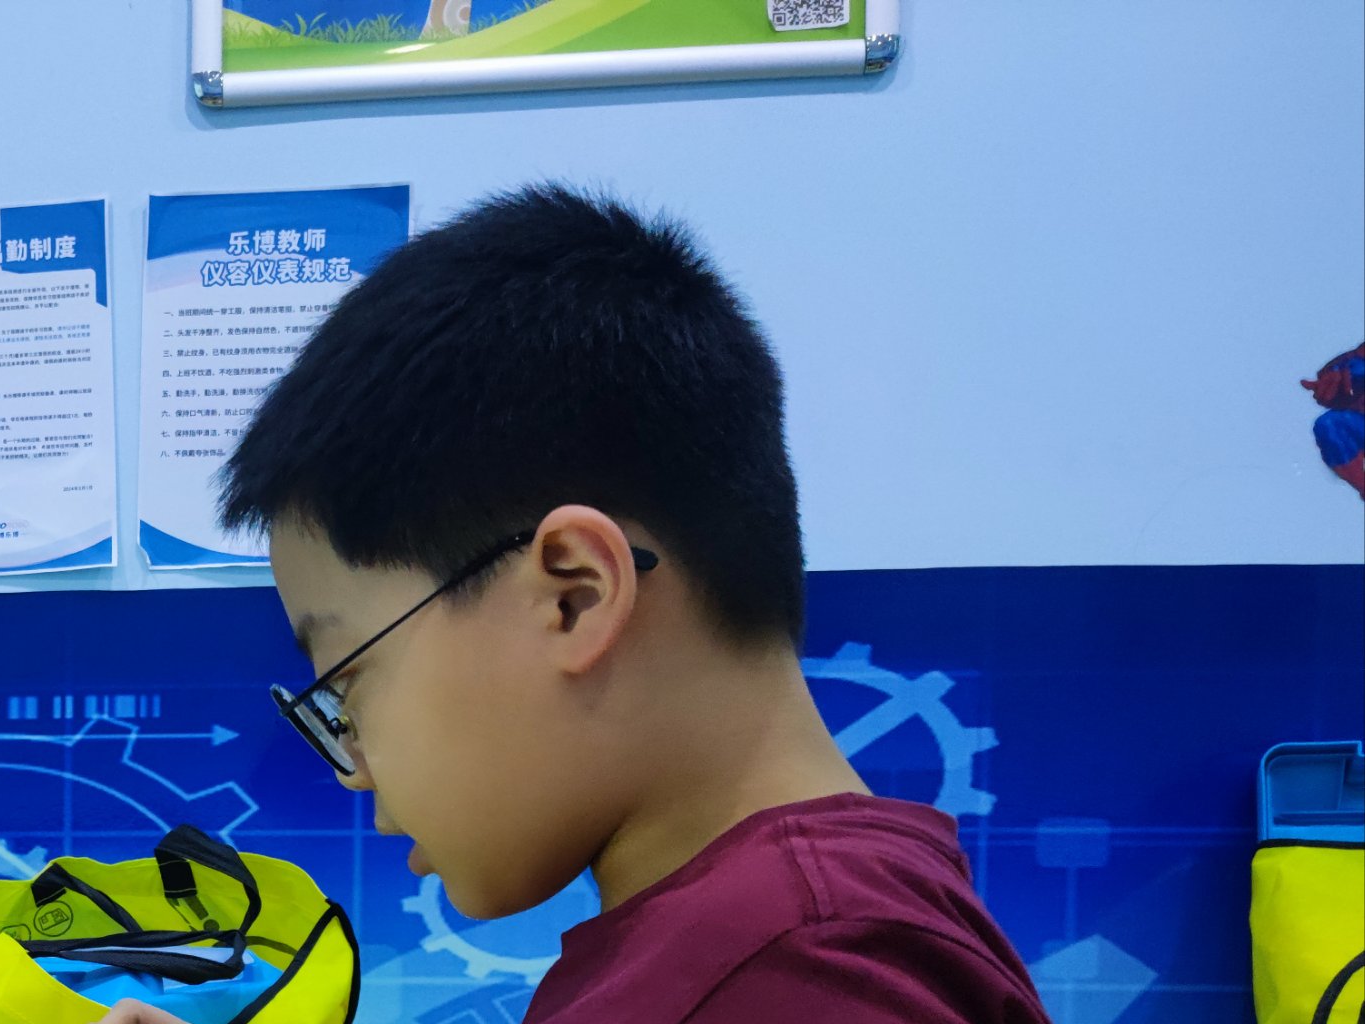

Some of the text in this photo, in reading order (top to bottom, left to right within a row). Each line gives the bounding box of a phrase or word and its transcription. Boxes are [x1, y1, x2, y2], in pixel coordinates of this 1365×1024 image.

[228, 228, 327, 256] 乐博教师
[201, 258, 352, 287] 仪容仪表规范
